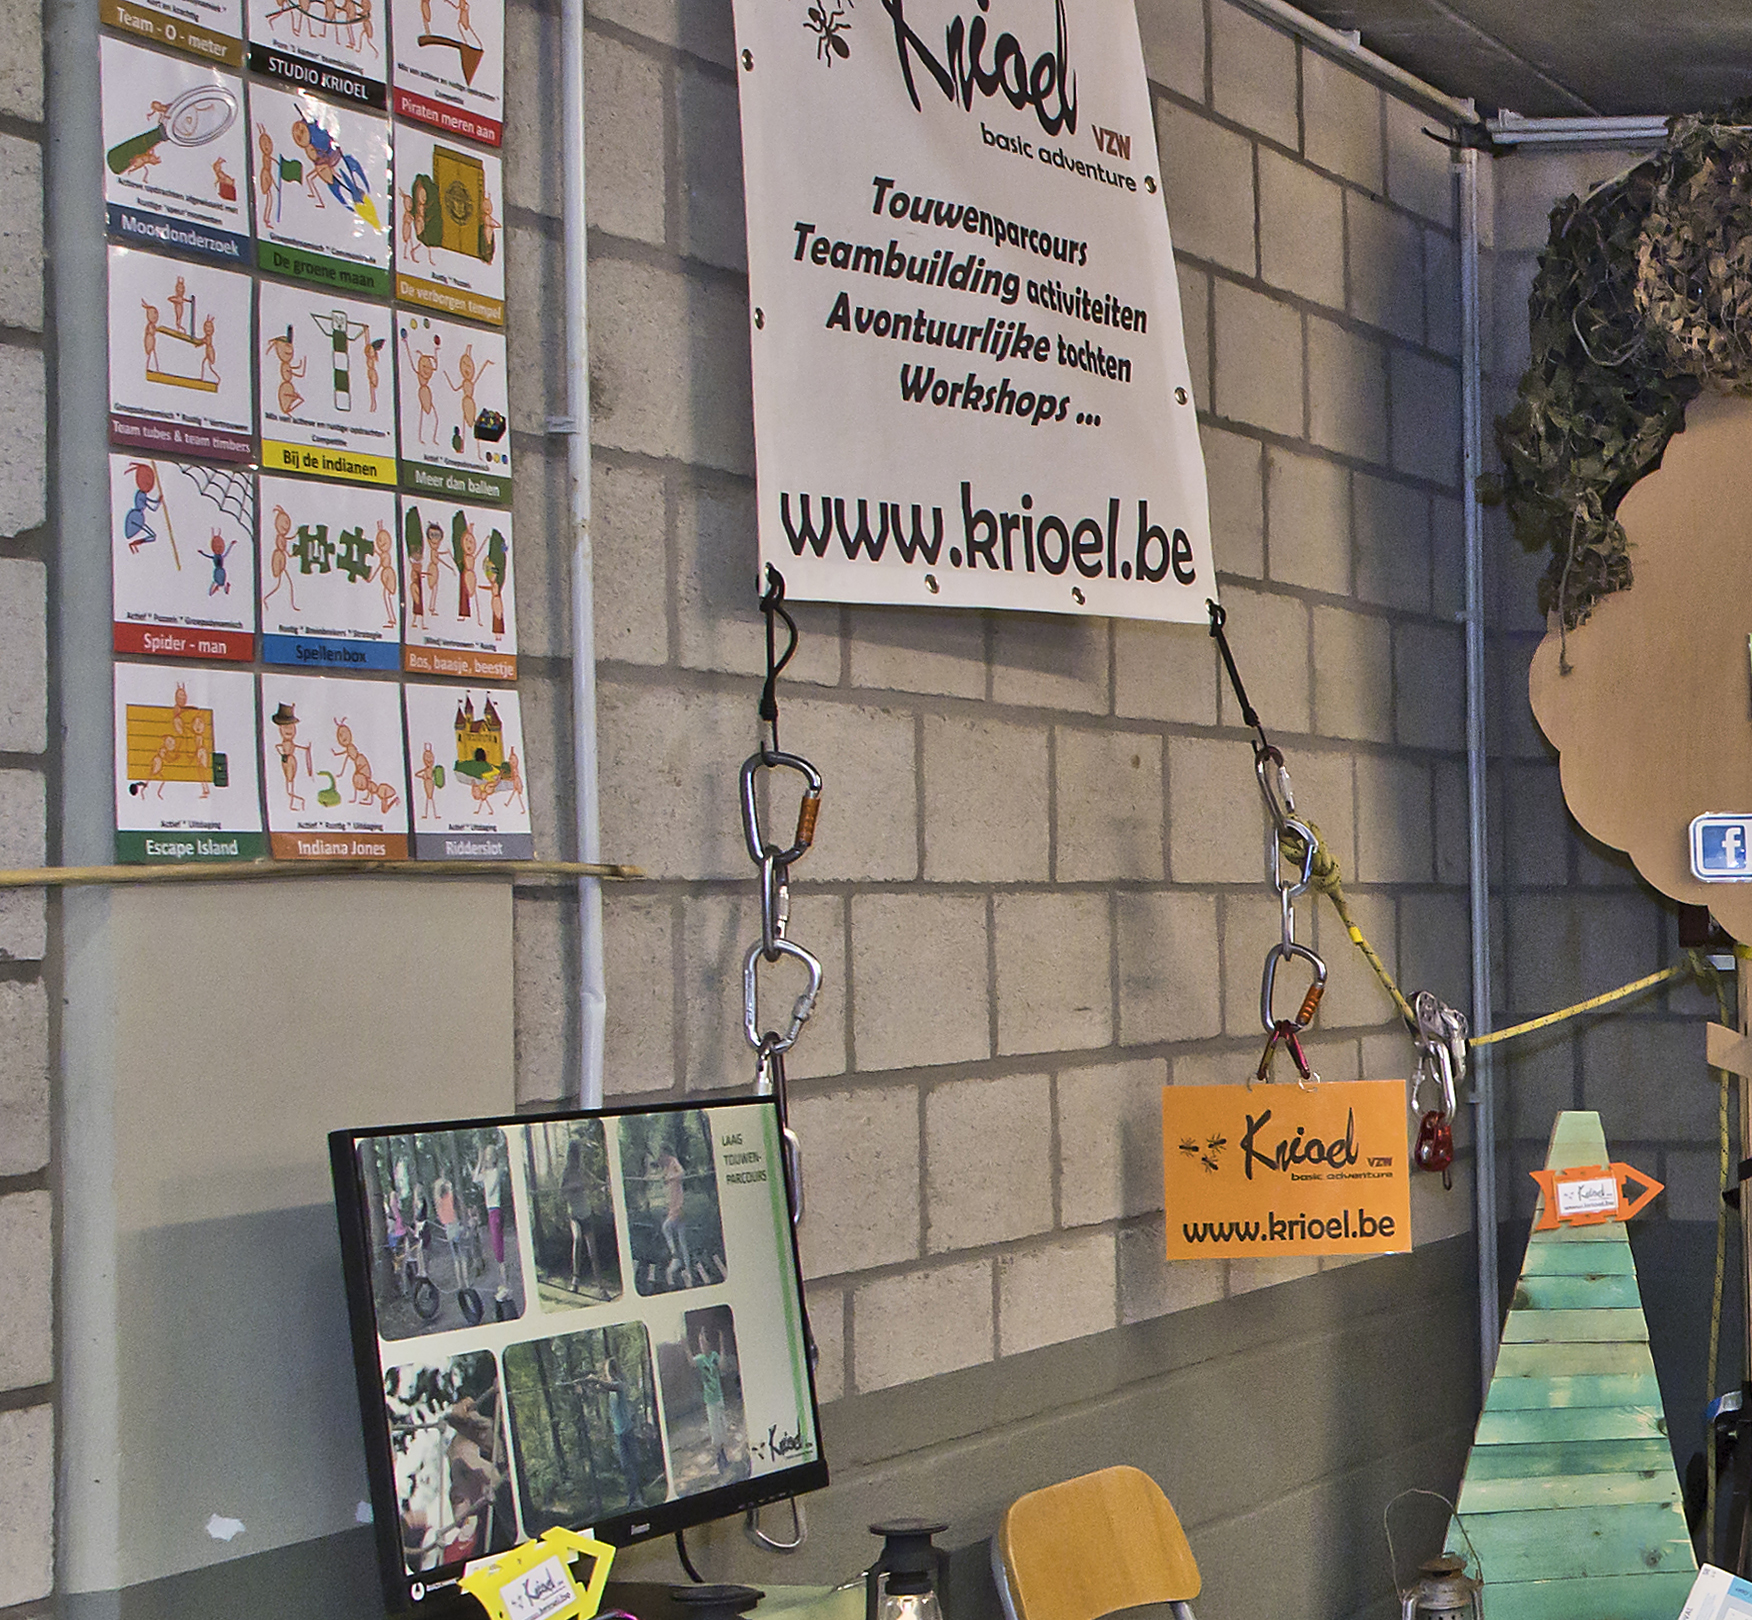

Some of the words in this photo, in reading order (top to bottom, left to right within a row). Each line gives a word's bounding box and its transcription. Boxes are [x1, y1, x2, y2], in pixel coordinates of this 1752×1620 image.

[116, 6, 153, 33] Team
[165, 24, 177, 40] O
[188, 34, 228, 57] meter
[268, 56, 319, 85] STUDIO
[321, 72, 369, 100] KRIOEL
[401, 97, 439, 122] Piraten
[441, 113, 475, 134] meren
[476, 125, 496, 140] aan
[981, 123, 1033, 160] basic
[1038, 147, 1137, 192] adventure
[1093, 125, 1131, 160] VZW
[122, 214, 240, 256] Moordonderzoek
[872, 176, 1088, 267] Touwenparcours
[273, 252, 290, 269] De
[293, 260, 336, 280] groene
[340, 271, 375, 288] maan
[793, 222, 1020, 305] Teambuilding
[1027, 281, 1148, 334] activiteiten
[400, 281, 414, 297] De
[417, 288, 466, 311] verborgen
[468, 301, 502, 319] tempel
[825, 292, 1050, 362] Avontuurlijke
[1057, 333, 1132, 383] tochten
[900, 364, 1070, 426] Workshops
[1076, 411, 1102, 427] ...
[113, 420, 141, 436] Team
[143, 427, 172, 441] tubes
[174, 430, 182, 442] &
[185, 433, 211, 447] team
[213, 437, 251, 453] timbers
[283, 449, 300, 469] Bij
[303, 452, 319, 468] de
[322, 456, 378, 477] indianen
[415, 469, 443, 487] Meer
[446, 475, 465, 491] dan
[468, 478, 500, 497] ballen
[780, 481, 1196, 585] www.krioel.be
[144, 632, 186, 652] Spider
[198, 640, 227, 655] man
[296, 644, 367, 663] Spellenbox
[409, 653, 431, 670] Bos,
[434, 654, 472, 675] baasje,
[475, 658, 514, 678] beestje
[145, 839, 195, 858] Escape
[196, 839, 239, 856] Island
[298, 839, 349, 856] Indiana
[351, 840, 386, 856] Jones
[445, 840, 503, 855] Ridderslot
[1240, 1107, 1359, 1180] Krioel
[1291, 1172, 1323, 1181] basic
[1327, 1171, 1393, 1180] adventure
[1367, 1157, 1393, 1168] VZW
[1183, 1208, 1395, 1243] www.krioel.be
